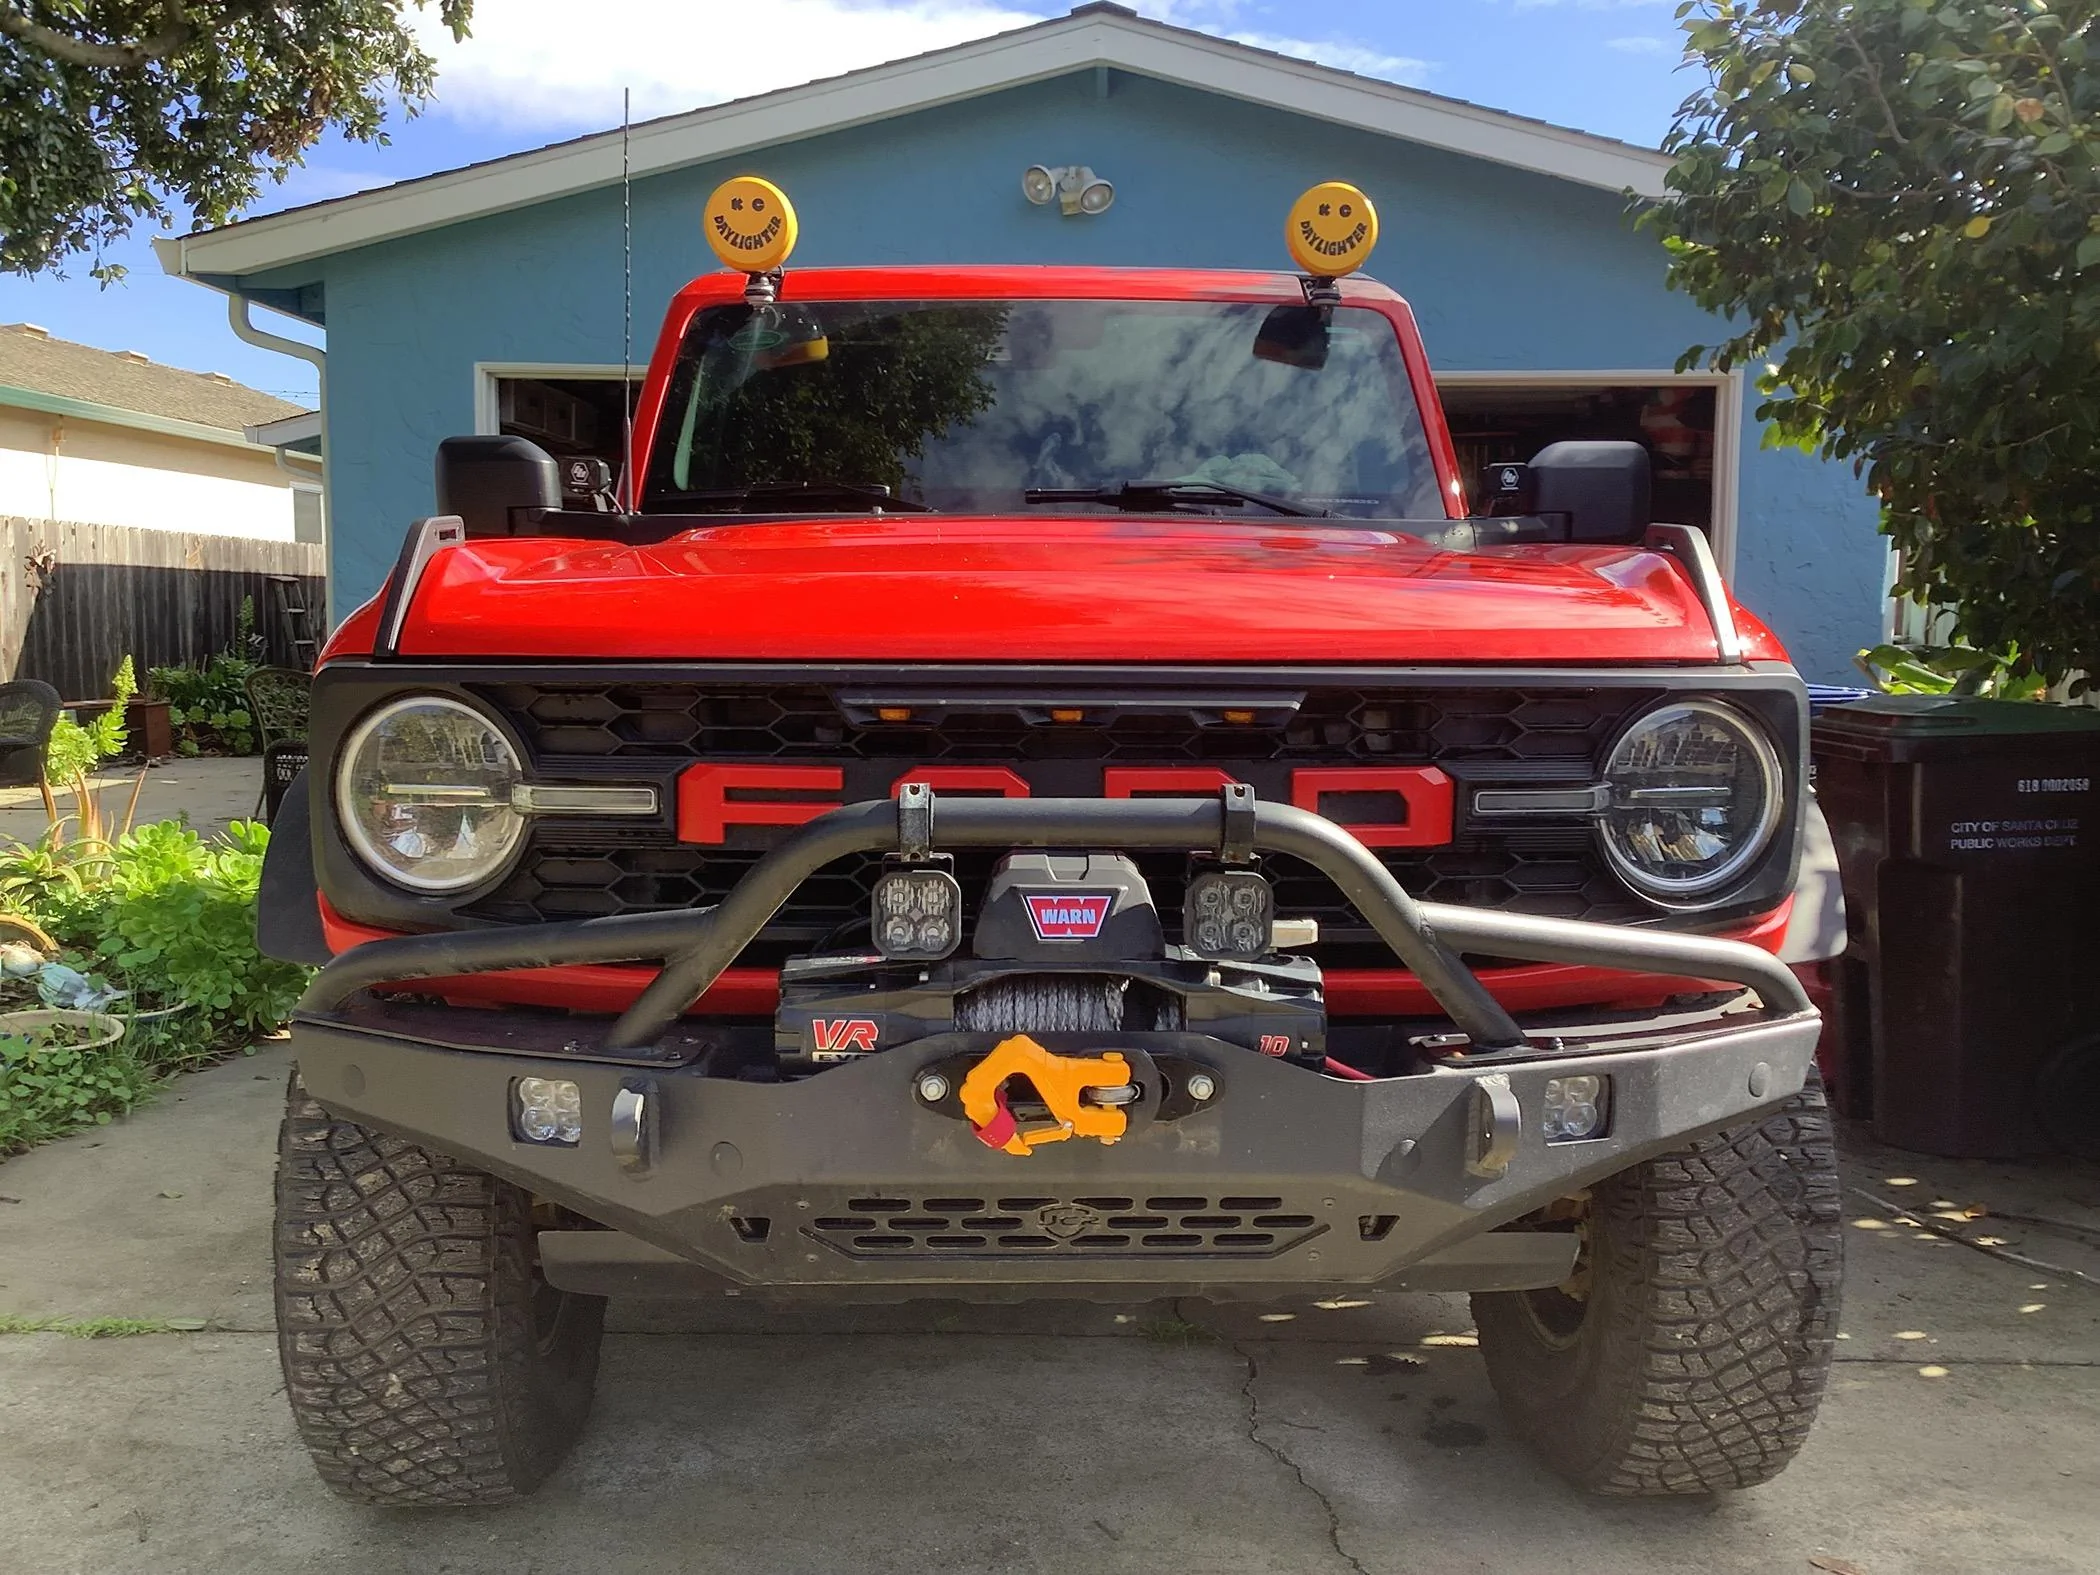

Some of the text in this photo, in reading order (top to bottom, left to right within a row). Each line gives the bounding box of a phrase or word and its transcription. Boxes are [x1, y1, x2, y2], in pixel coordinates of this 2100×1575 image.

[714, 215, 782, 250] DAYLIGHTER
[1301, 220, 1367, 256] DAYLIGHTER
[2018, 779, 2040, 793] 618
[1951, 822, 1979, 833] CITY
[1982, 821, 2000, 832] OF
[2002, 820, 2043, 831] SANTA
[1951, 838, 1994, 849] PUBLIC
[1996, 836, 2041, 848] WORKS
[1041, 908, 1096, 925] WARN
[812, 1019, 879, 1051] VR
[1260, 1035, 1290, 1057] 10
